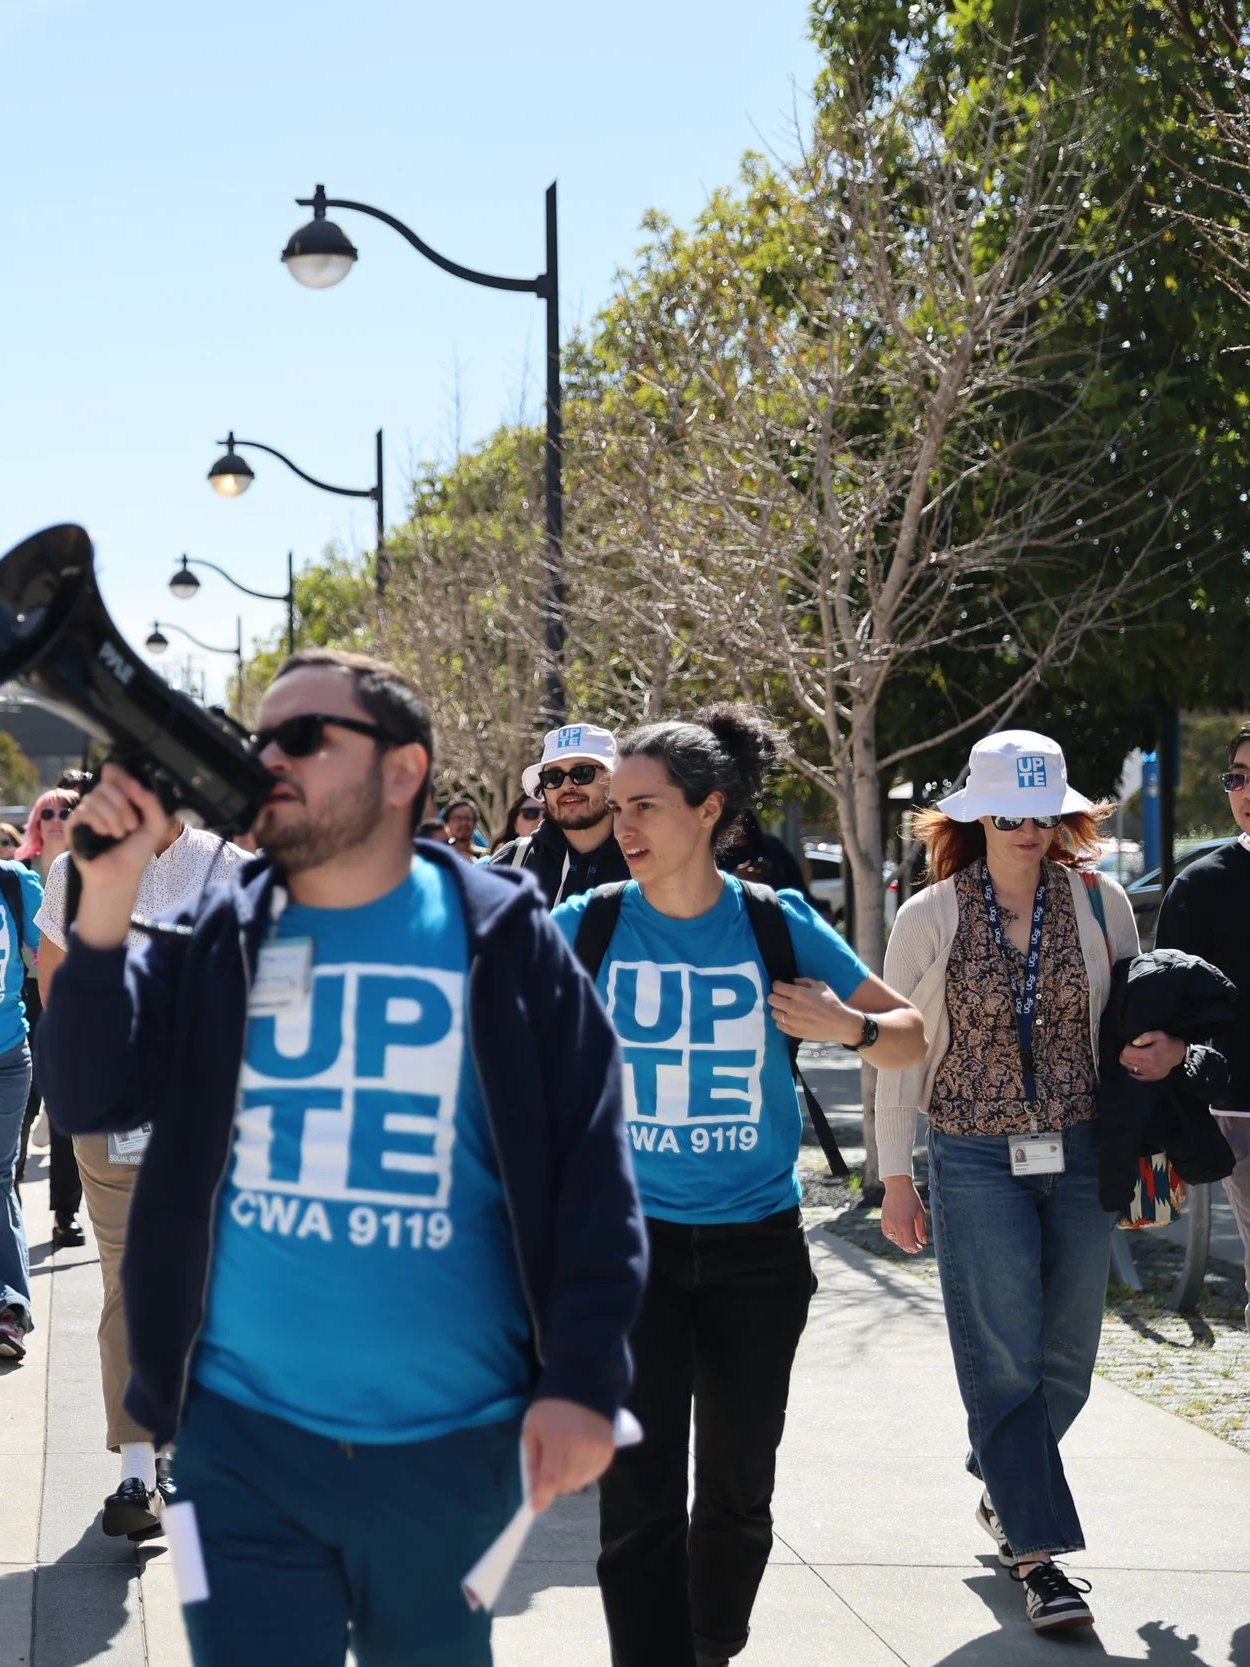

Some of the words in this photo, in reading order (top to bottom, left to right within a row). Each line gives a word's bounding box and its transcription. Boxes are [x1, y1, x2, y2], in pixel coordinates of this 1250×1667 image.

[560, 728, 580, 739] UP
[559, 738, 579, 747] TE
[1018, 757, 1044, 772] UP
[1019, 772, 1045, 786] TE
[984, 885, 993, 900] UCSF
[989, 906, 997, 922] UCSF
[1033, 905, 1044, 922] UCSF
[1031, 928, 1041, 944] UCSF
[1028, 950, 1038, 967] UCSF
[1026, 974, 1036, 990] UCSF
[612, 968, 759, 1044] UP
[1023, 997, 1033, 1014] UCSF
[243, 972, 454, 1081] UP
[621, 1048, 757, 1118] TE
[241, 1087, 442, 1197] TE
[626, 1125, 680, 1153] WA
[690, 1126, 759, 1153] 9119
[229, 1191, 333, 1241] CWA
[348, 1206, 454, 1249] 9119
